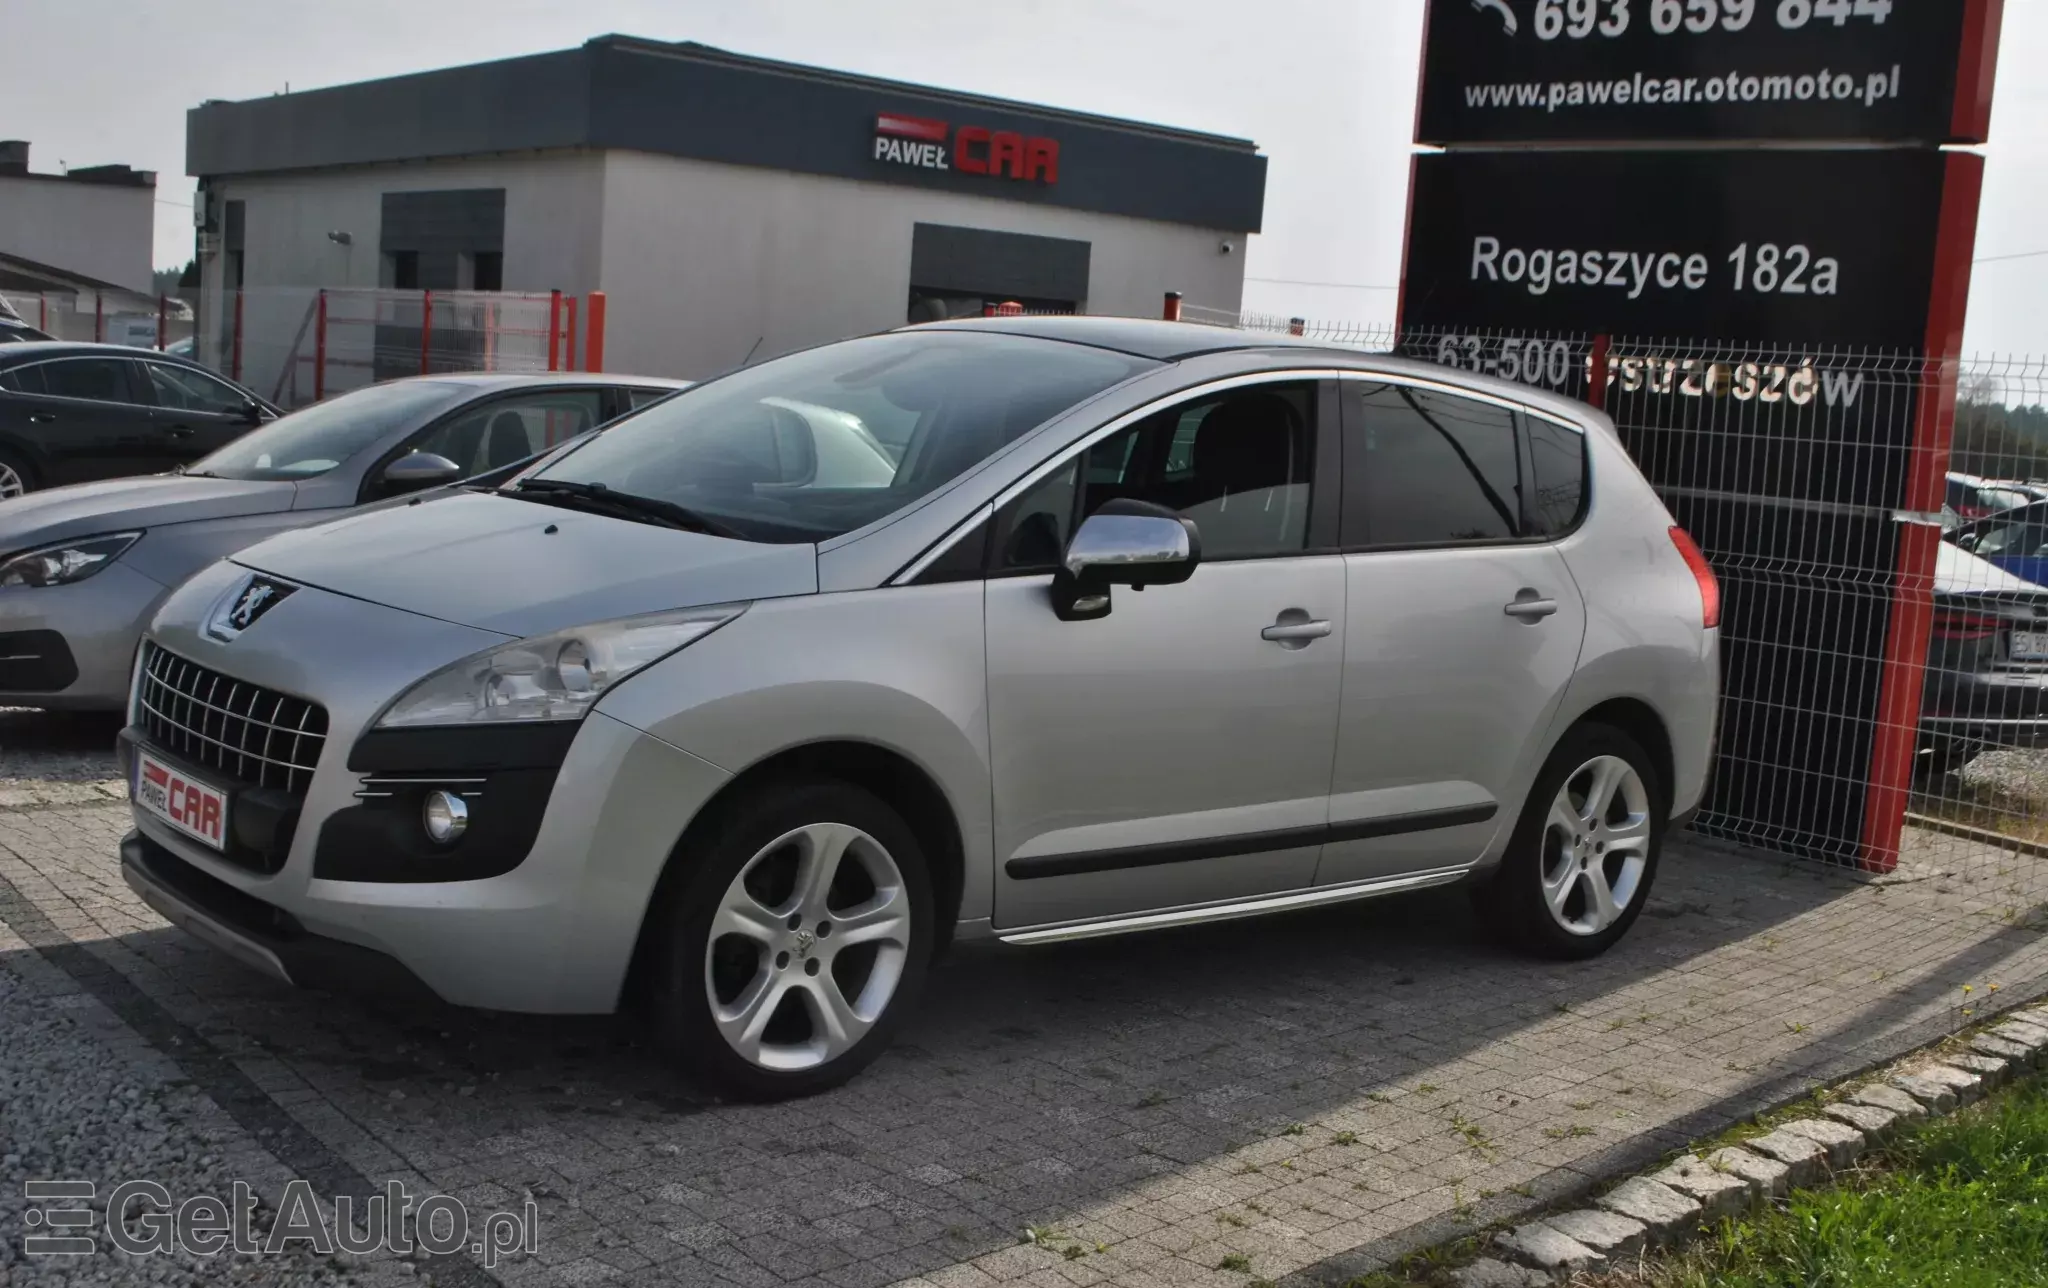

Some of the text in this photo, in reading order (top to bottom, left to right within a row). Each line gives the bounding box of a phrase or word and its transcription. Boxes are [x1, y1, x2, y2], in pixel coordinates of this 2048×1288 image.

[1534, 0, 1630, 40] 693
[1650, 0, 1756, 34] 659
[1465, 65, 1900, 112] www.pawelcar.otomoto.pl
[875, 127, 1060, 183] PAWEŁ CAR
[1470, 236, 1840, 299] Rogaszyce 182a
[1437, 333, 1570, 386] 63-500
[169, 778, 220, 840] CAR
